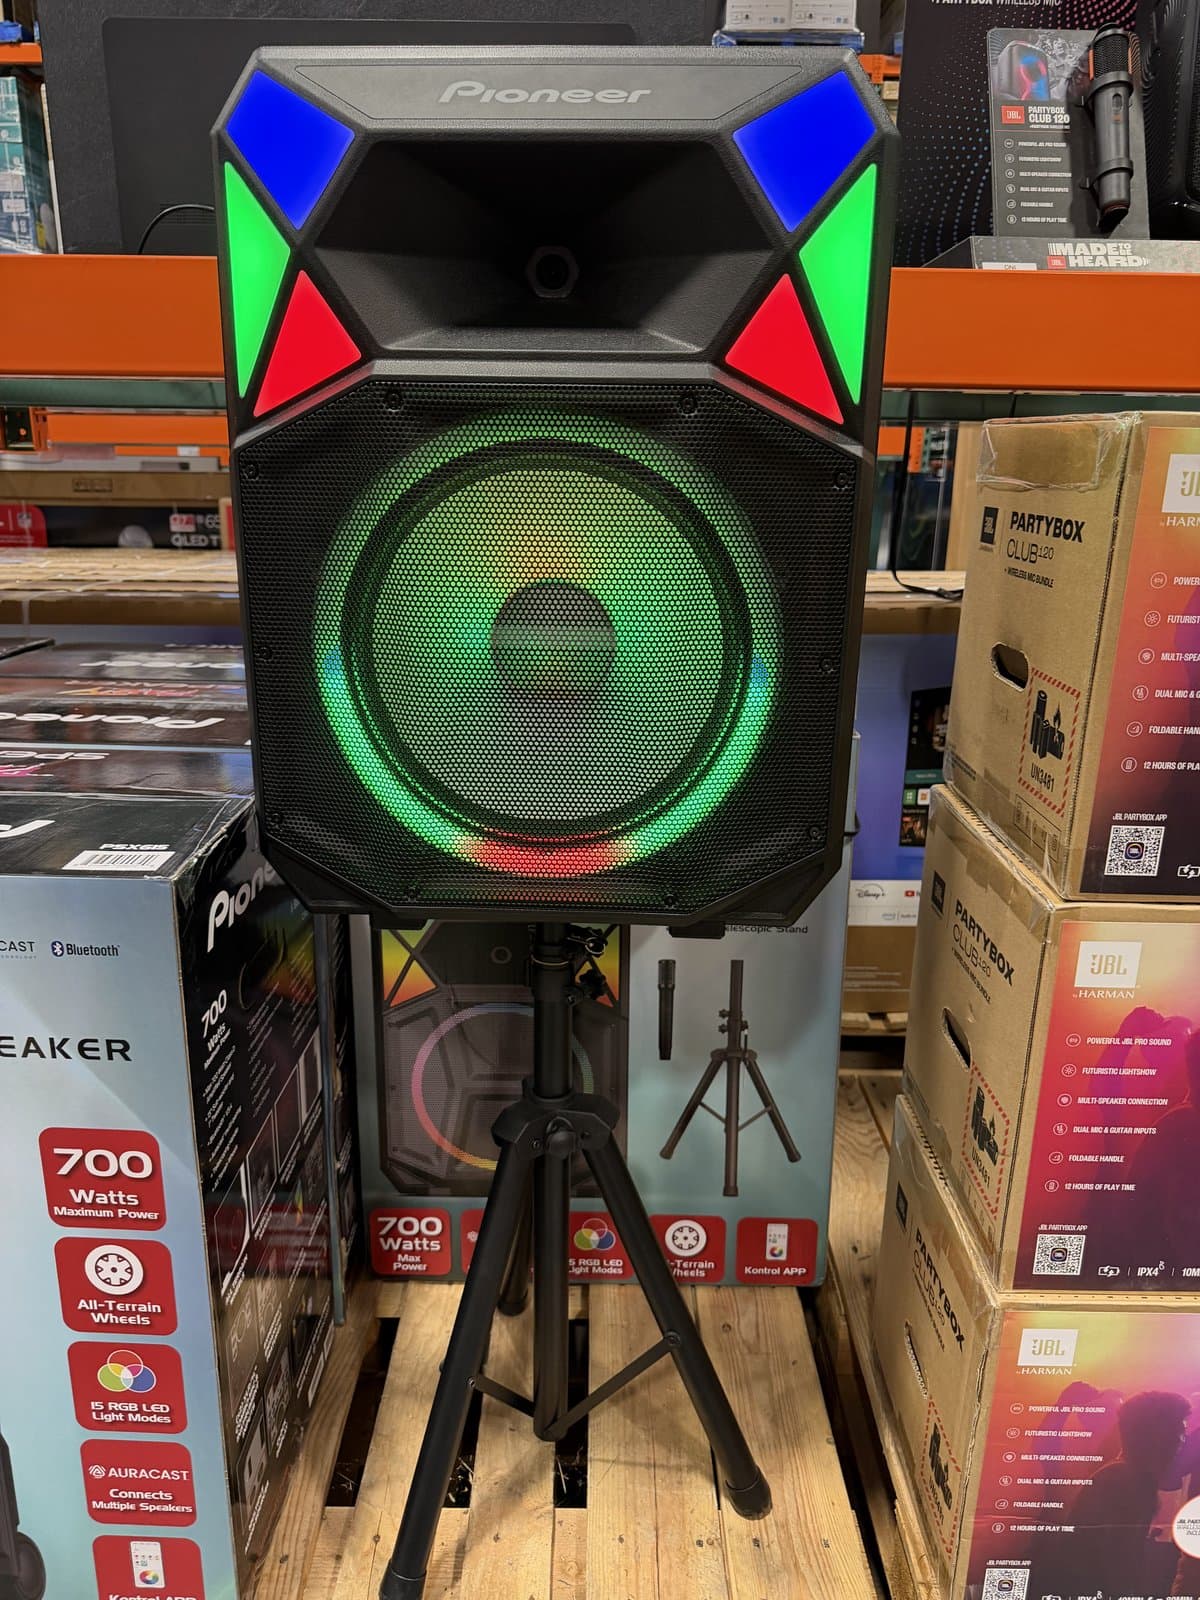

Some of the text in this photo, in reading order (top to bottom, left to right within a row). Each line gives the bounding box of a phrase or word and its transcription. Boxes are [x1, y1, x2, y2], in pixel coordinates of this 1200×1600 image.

[438, 80, 652, 104] Pioneer
[1028, 106, 1065, 114] PARTYBOX
[1029, 114, 1071, 124] CLUB 120
[1055, 242, 1118, 256] MADE
[1068, 256, 1142, 267] HEARD
[1010, 511, 1085, 543] PARTYBOX
[1154, 689, 1174, 698] DUAL
[1174, 690, 1188, 698] MIC
[1148, 725, 1183, 734] FOLDABLE
[1152, 761, 1176, 770] HOURS
[1176, 762, 1186, 770] OF
[207, 861, 276, 953] Pione
[956, 898, 1014, 987] PARTYBOX
[66, 944, 120, 957] Bluetooth
[1090, 954, 1128, 976] JBL
[1078, 989, 1135, 999] HARMAN
[202, 989, 227, 1039] 700
[1086, 1036, 1120, 1045] POWERFUL
[1134, 1038, 1148, 1046] PRO
[1148, 1038, 1172, 1046] SOUND
[1082, 1067, 1157, 1076] FUTURISTIC LIGHTSHOW
[1078, 1096, 1168, 1106] MULTI-SPEAKER CONNECTION
[52, 1148, 153, 1180] 700
[1068, 1154, 1125, 1163] FOLDABLE HANDLE
[1104, 1184, 1120, 1192] PLAY
[1120, 1184, 1136, 1192] TIME
[69, 1188, 139, 1206] Watts
[53, 1206, 160, 1221] Maximum Power
[377, 1216, 442, 1238] 700
[380, 1238, 442, 1252] Watts
[398, 1254, 422, 1262] Max
[604, 1259, 623, 1267] LED
[393, 1262, 428, 1272] Power
[592, 1266, 623, 1275] Modes
[668, 1260, 715, 1270] -Terrain
[744, 1266, 807, 1276] Kontrol APP
[77, 1299, 162, 1314] All-Terrain
[91, 1312, 151, 1326] Wheels
[1032, 1339, 1066, 1356] JBL
[1022, 1367, 1072, 1376] HARMAN
[108, 1402, 138, 1412] RGB
[142, 1403, 170, 1414] LED
[92, 1411, 172, 1424] Light Modes
[108, 1467, 190, 1481] AURACAST
[109, 1488, 173, 1501] Connects
[92, 1500, 193, 1514] Multiple Speakers
